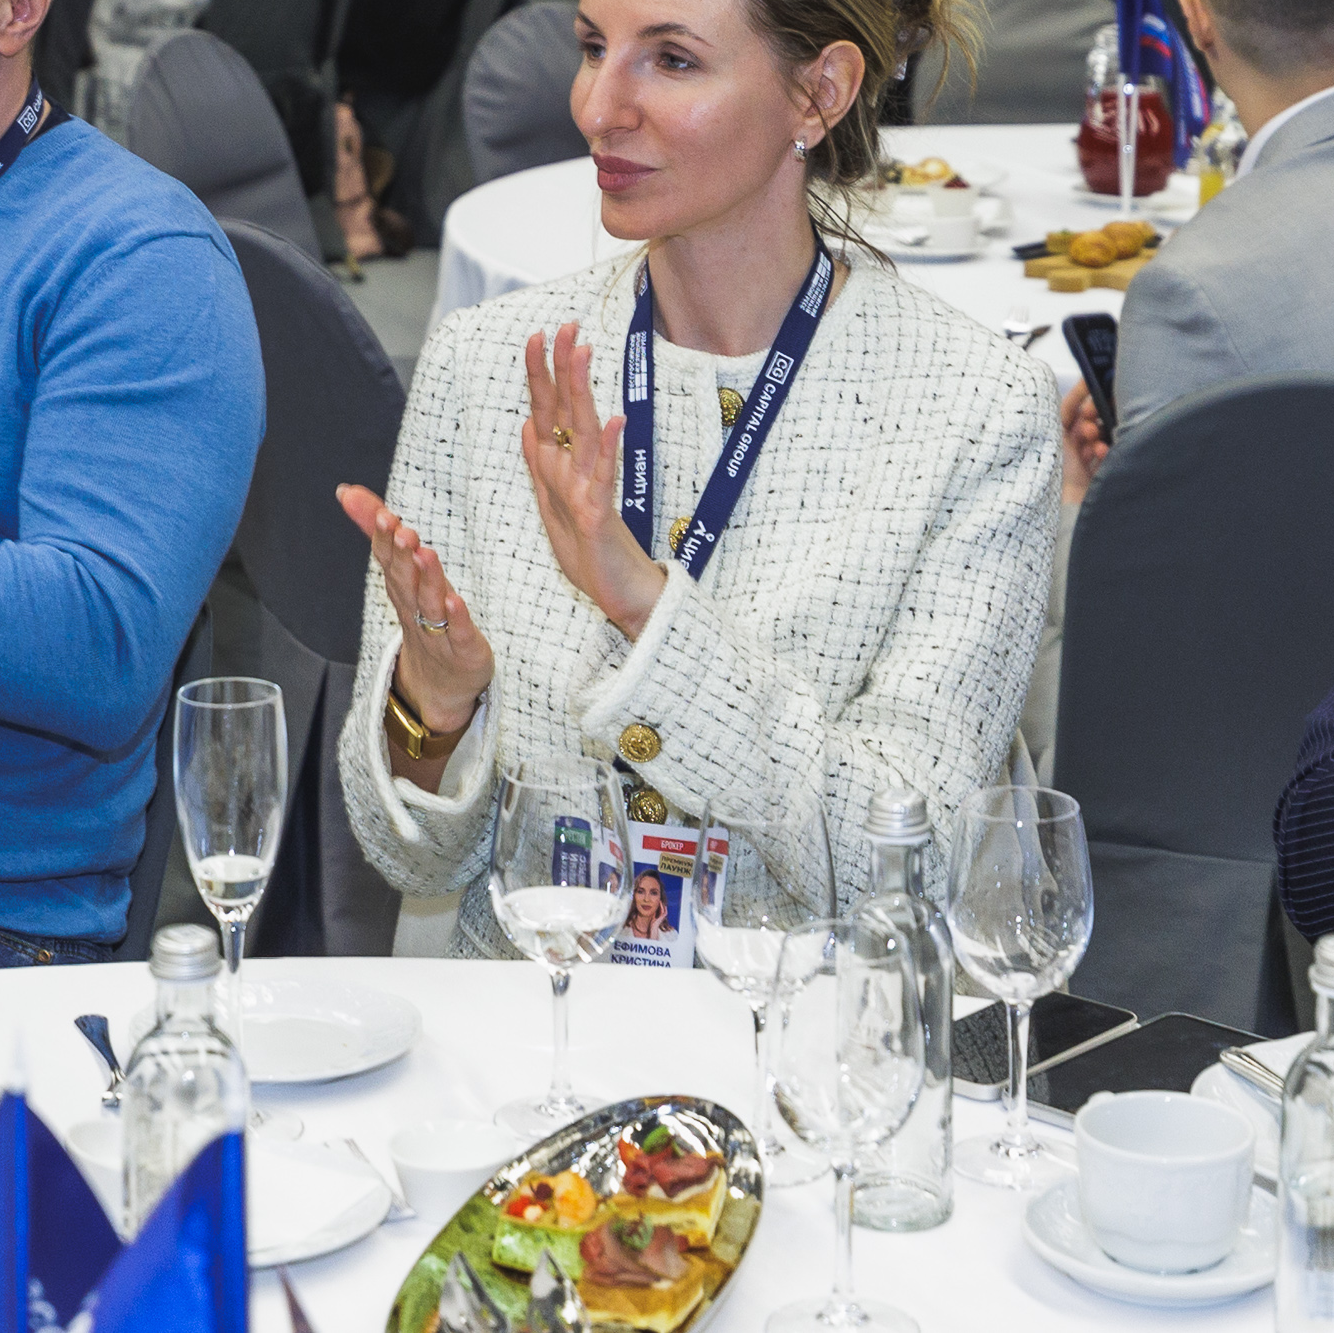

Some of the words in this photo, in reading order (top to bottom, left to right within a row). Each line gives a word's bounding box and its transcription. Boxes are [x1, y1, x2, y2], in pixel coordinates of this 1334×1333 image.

[741, 382, 777, 436] CAPITAL
[726, 433, 754, 478] GROUP
[633, 449, 647, 495] циан
[661, 840, 684, 850] БРОКЕР
[660, 863, 692, 875] ЛАУНЖ
[662, 855, 693, 867] ПРЕМИУМ
[614, 940, 671, 958] ЕФИМОВА
[611, 954, 671, 968] КРИСТИНА
